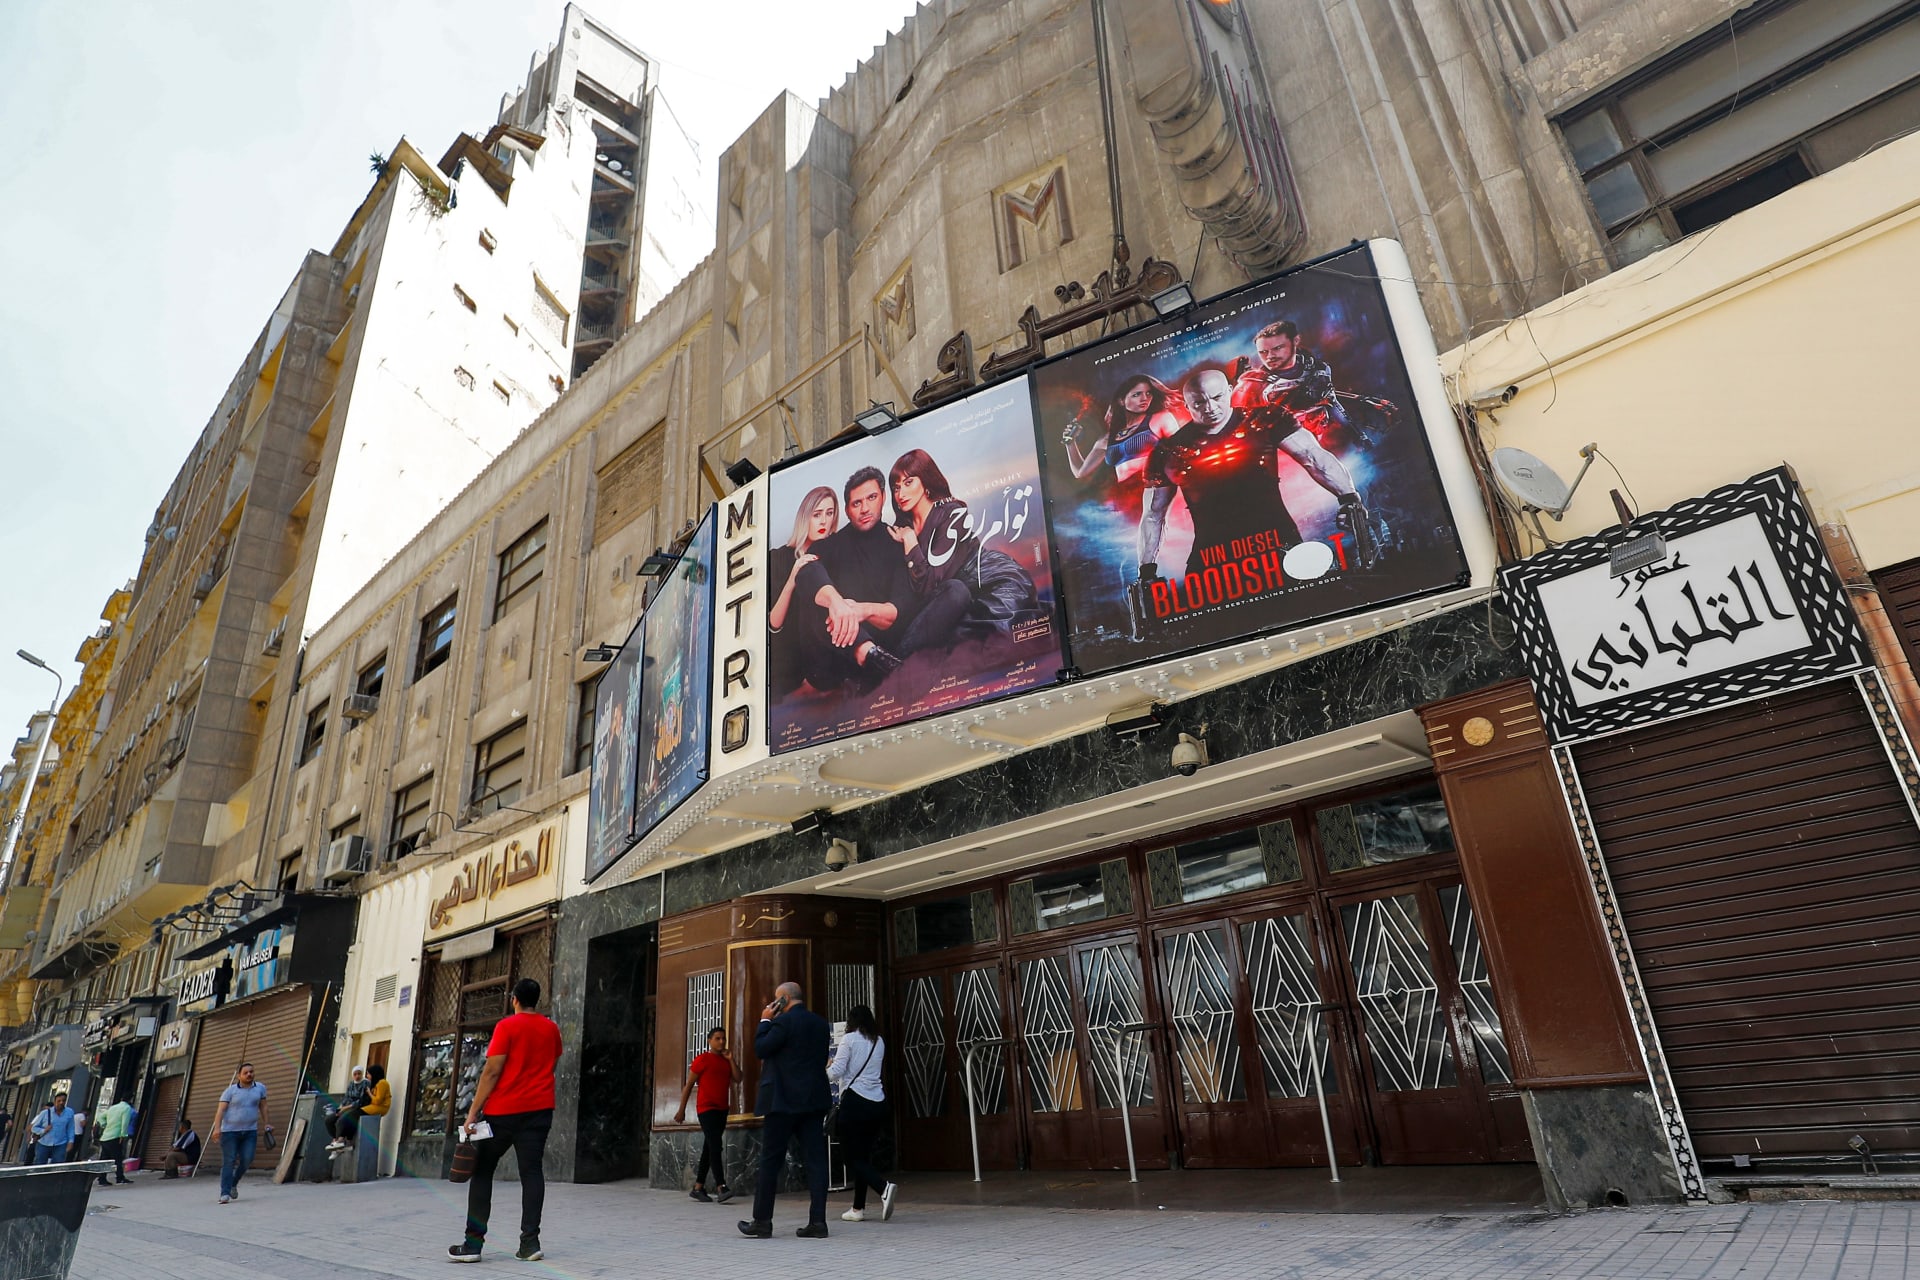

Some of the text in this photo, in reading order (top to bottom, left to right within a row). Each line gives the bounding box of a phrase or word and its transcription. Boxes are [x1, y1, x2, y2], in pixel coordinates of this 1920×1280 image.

[1094, 352, 1120, 366] FROM
[1123, 330, 1182, 354] PRODUCERS
[1185, 323, 1200, 333] OF
[1202, 313, 1227, 327] FAST
[1240, 292, 1287, 313] FURIOUS
[1184, 326, 1230, 347] SUPERHERO
[978, 485, 1033, 589] توأم
[1200, 528, 1283, 567] VIN DIESEL
[1151, 532, 1349, 619] BLOODSHT
[1163, 575, 1342, 625] BASED ON THE BEST-SELLING COMIC BOOK
[721, 489, 754, 754] METRO
[177, 967, 217, 1007] LEADER
